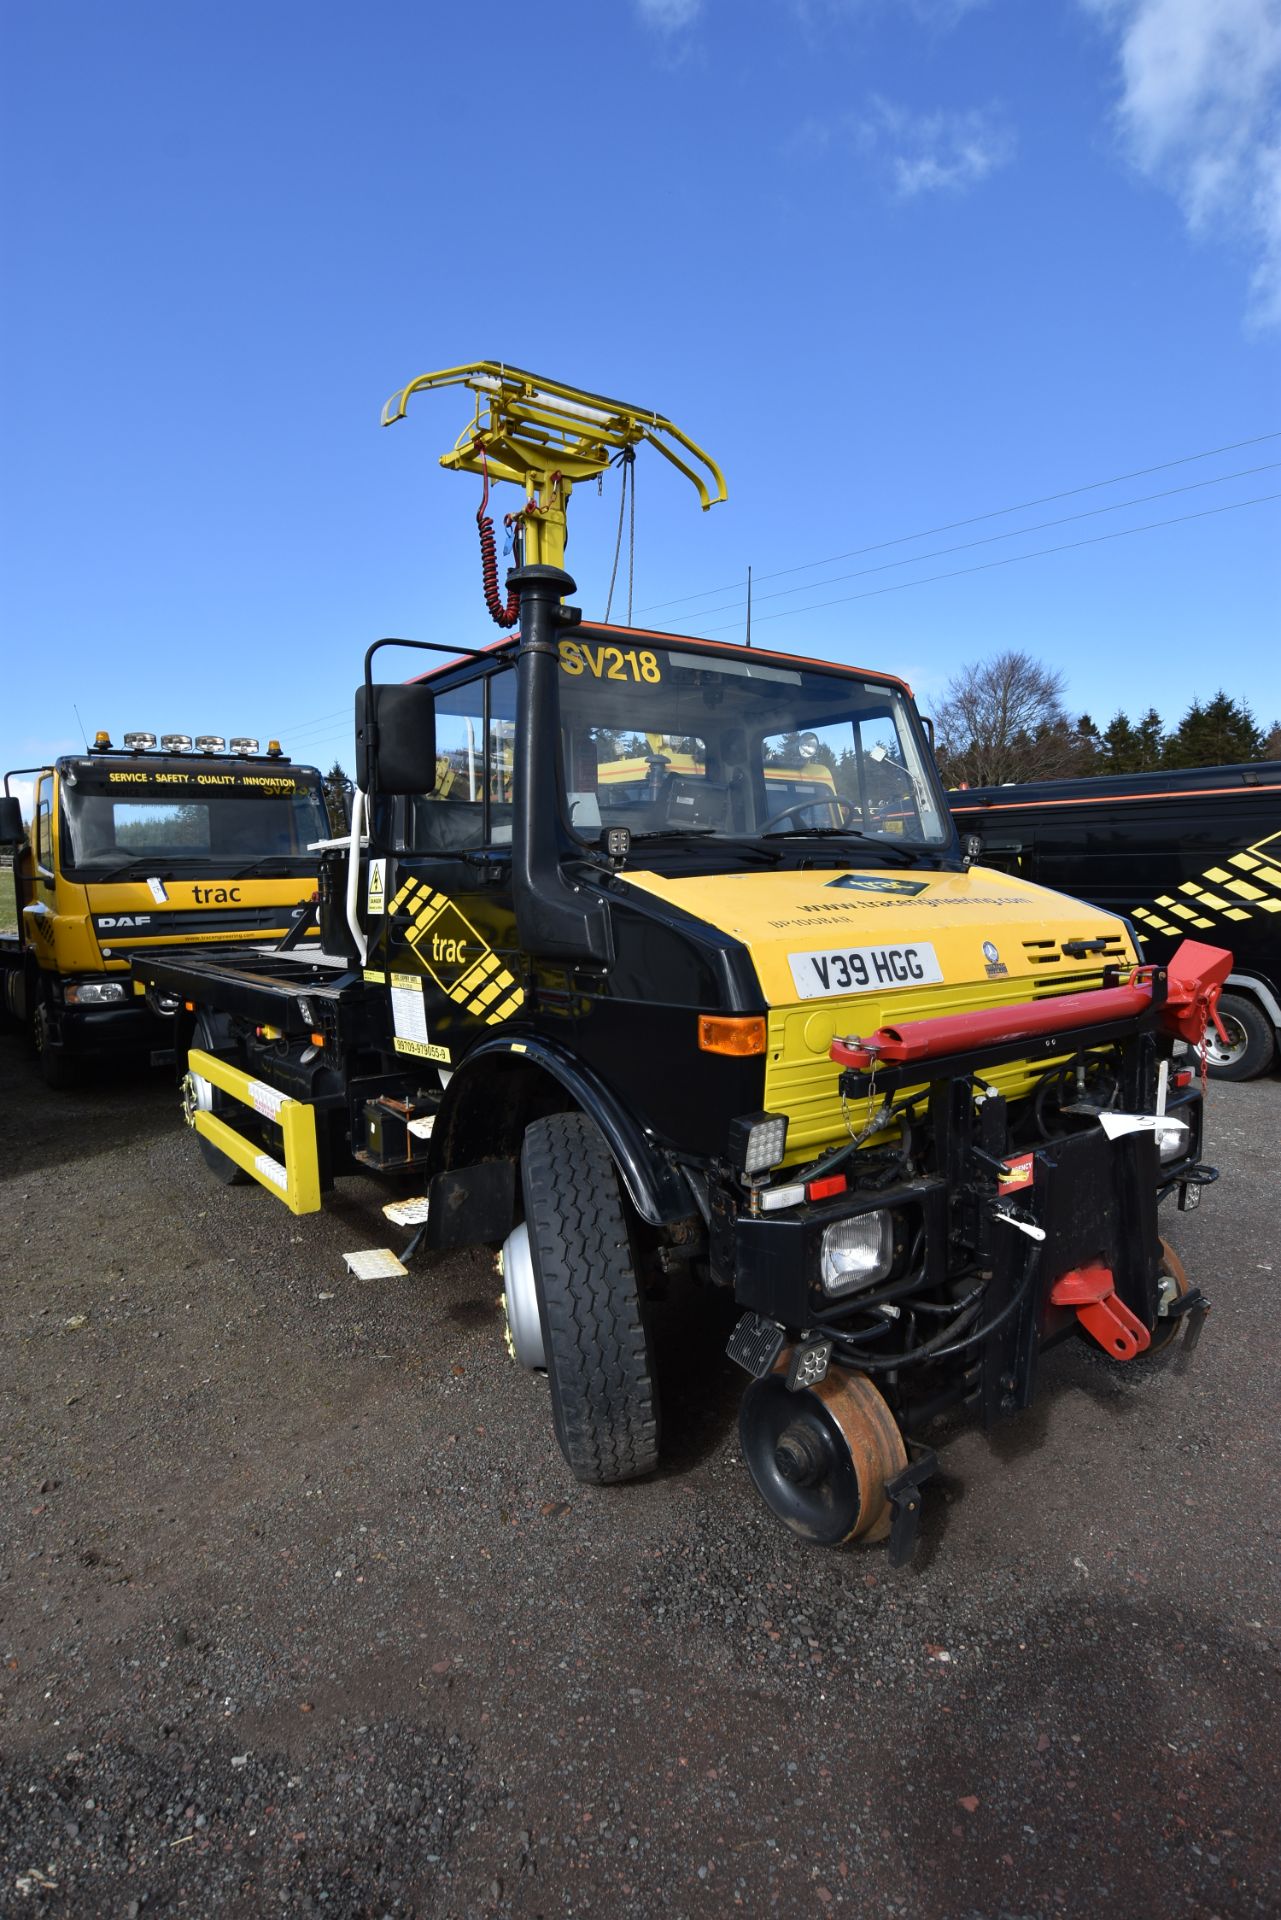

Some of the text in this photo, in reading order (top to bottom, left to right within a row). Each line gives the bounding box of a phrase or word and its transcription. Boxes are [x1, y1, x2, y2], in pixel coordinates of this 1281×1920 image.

[558, 641, 661, 683] SV218
[109, 773, 147, 783] SERVICE
[155, 774, 189, 783] SAFETY
[197, 775, 236, 785] QUALITY
[243, 776, 295, 787] INNOVATION
[849, 880, 914, 890] trac
[192, 885, 241, 904] trac
[797, 897, 1033, 913] www.tracengineering.com
[98, 916, 151, 928] DAF
[432, 932, 467, 964] trac
[811, 949, 924, 990] V39 HGG
